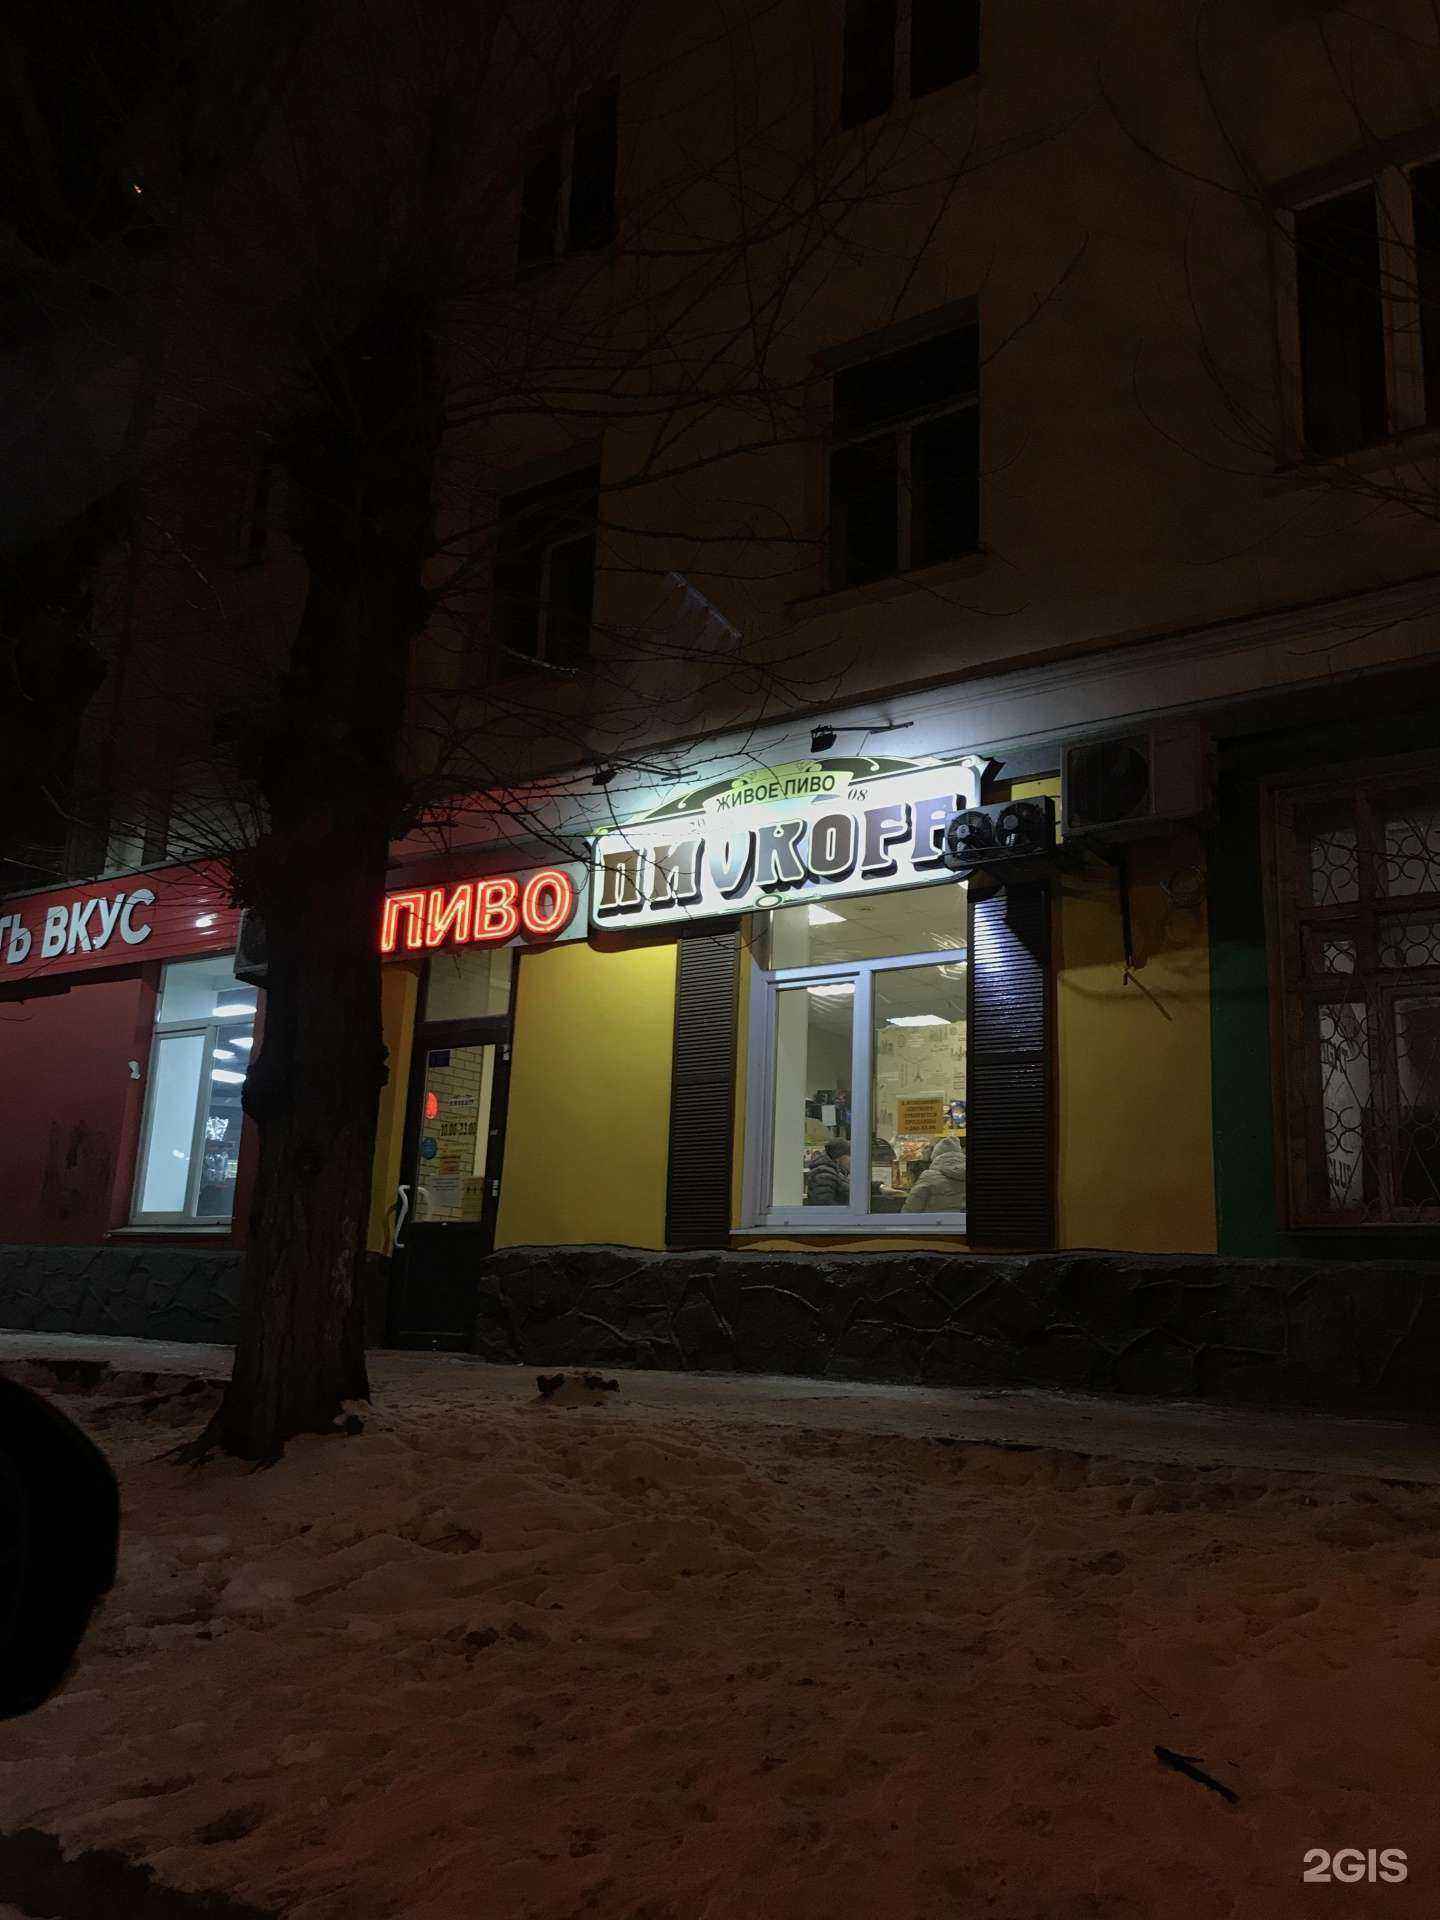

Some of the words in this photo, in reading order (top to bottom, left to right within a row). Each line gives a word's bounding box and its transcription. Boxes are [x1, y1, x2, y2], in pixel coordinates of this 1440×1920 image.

[716, 782, 780, 812] ЖИВОЕ
[784, 775, 835, 796] ПИВО
[848, 788, 868, 801] 08
[41, 888, 156, 959] ВКУС
[379, 869, 573, 953] ПИВО
